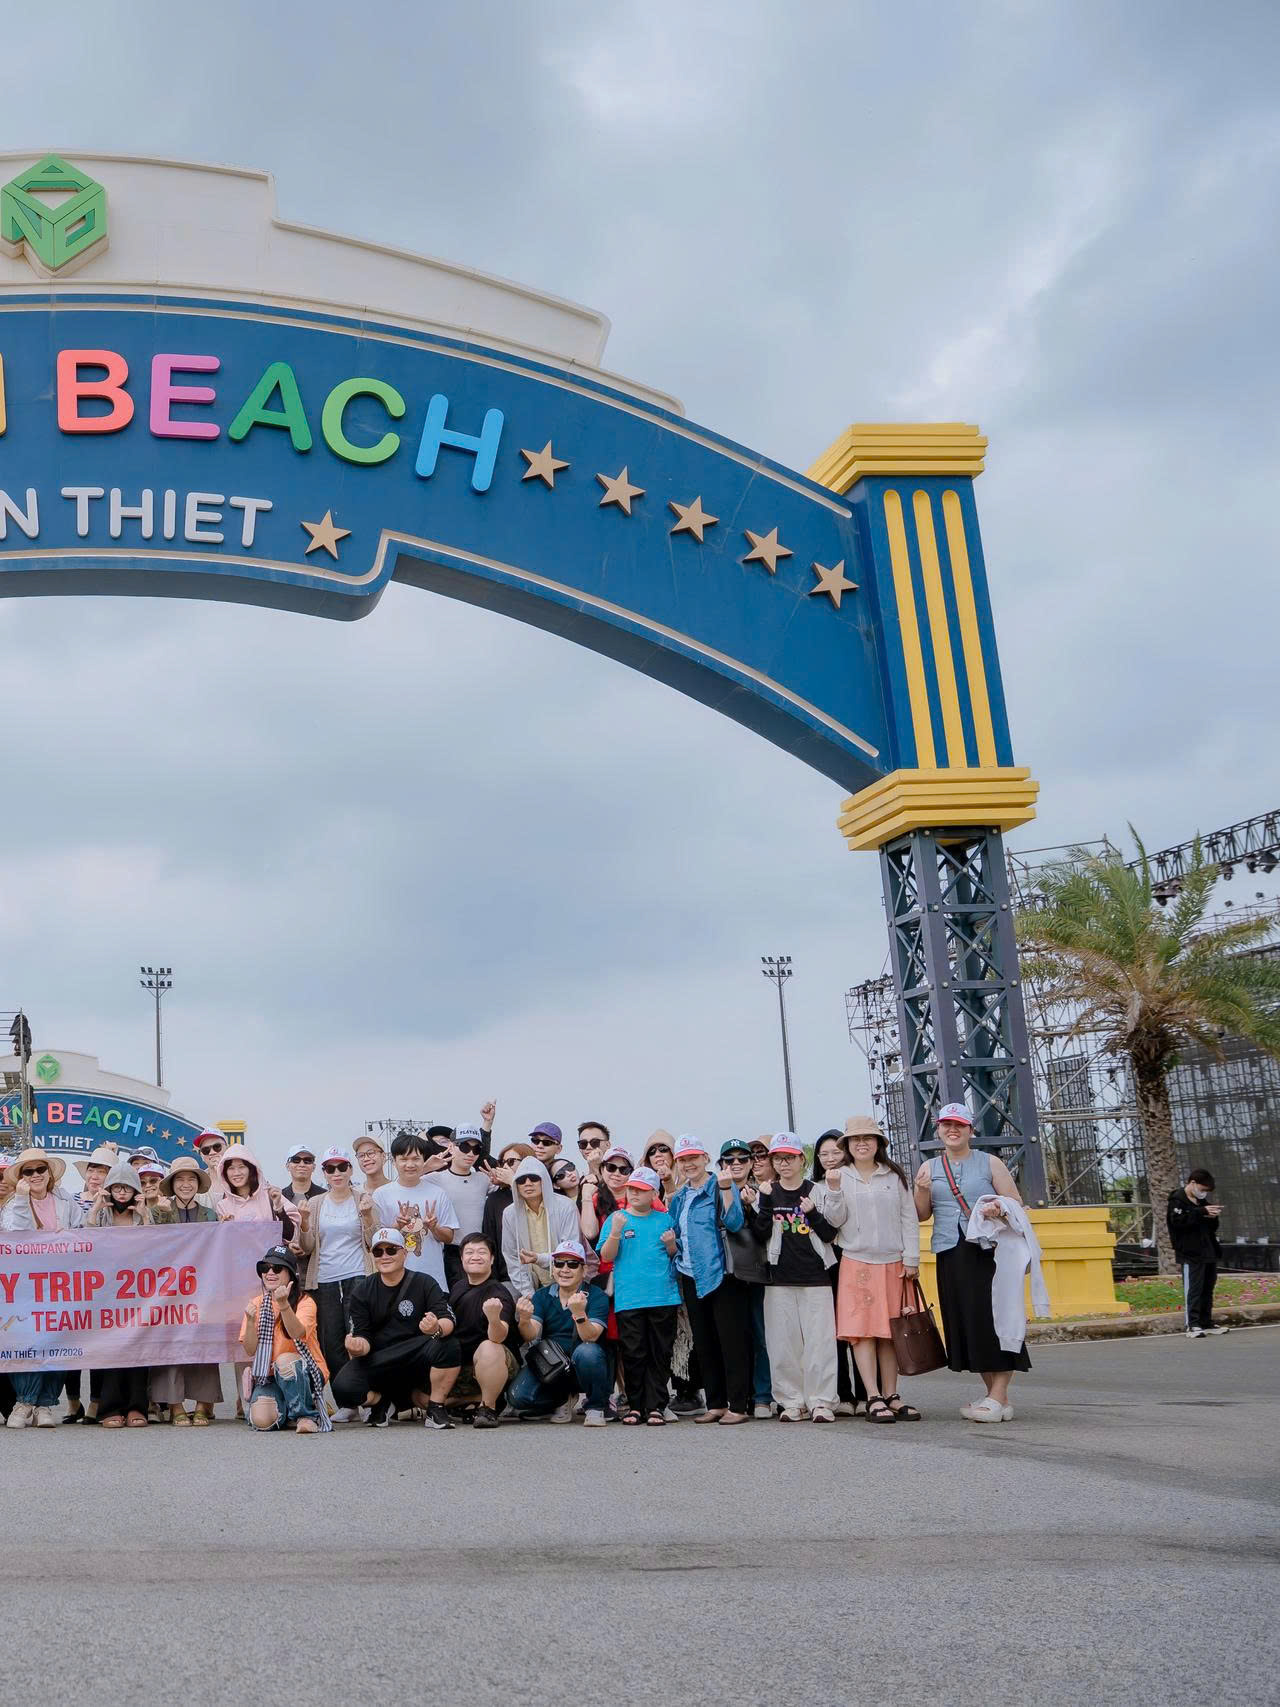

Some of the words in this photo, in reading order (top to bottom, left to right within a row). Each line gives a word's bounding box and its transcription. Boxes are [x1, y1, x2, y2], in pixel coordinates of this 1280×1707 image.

[56, 349, 505, 494] BEACH
[61, 486, 273, 548] THIET
[47, 1102, 143, 1137] BEACH
[49, 1135, 94, 1150] THIET
[15, 1242, 70, 1255] COMPANY
[73, 1241, 93, 1253] LTD
[28, 1270, 105, 1303] TRIP
[115, 1265, 198, 1300] 2026
[31, 1309, 93, 1333] TEAM
[100, 1303, 199, 1329] BUILDING
[49, 1347, 83, 1358] 07/2026
